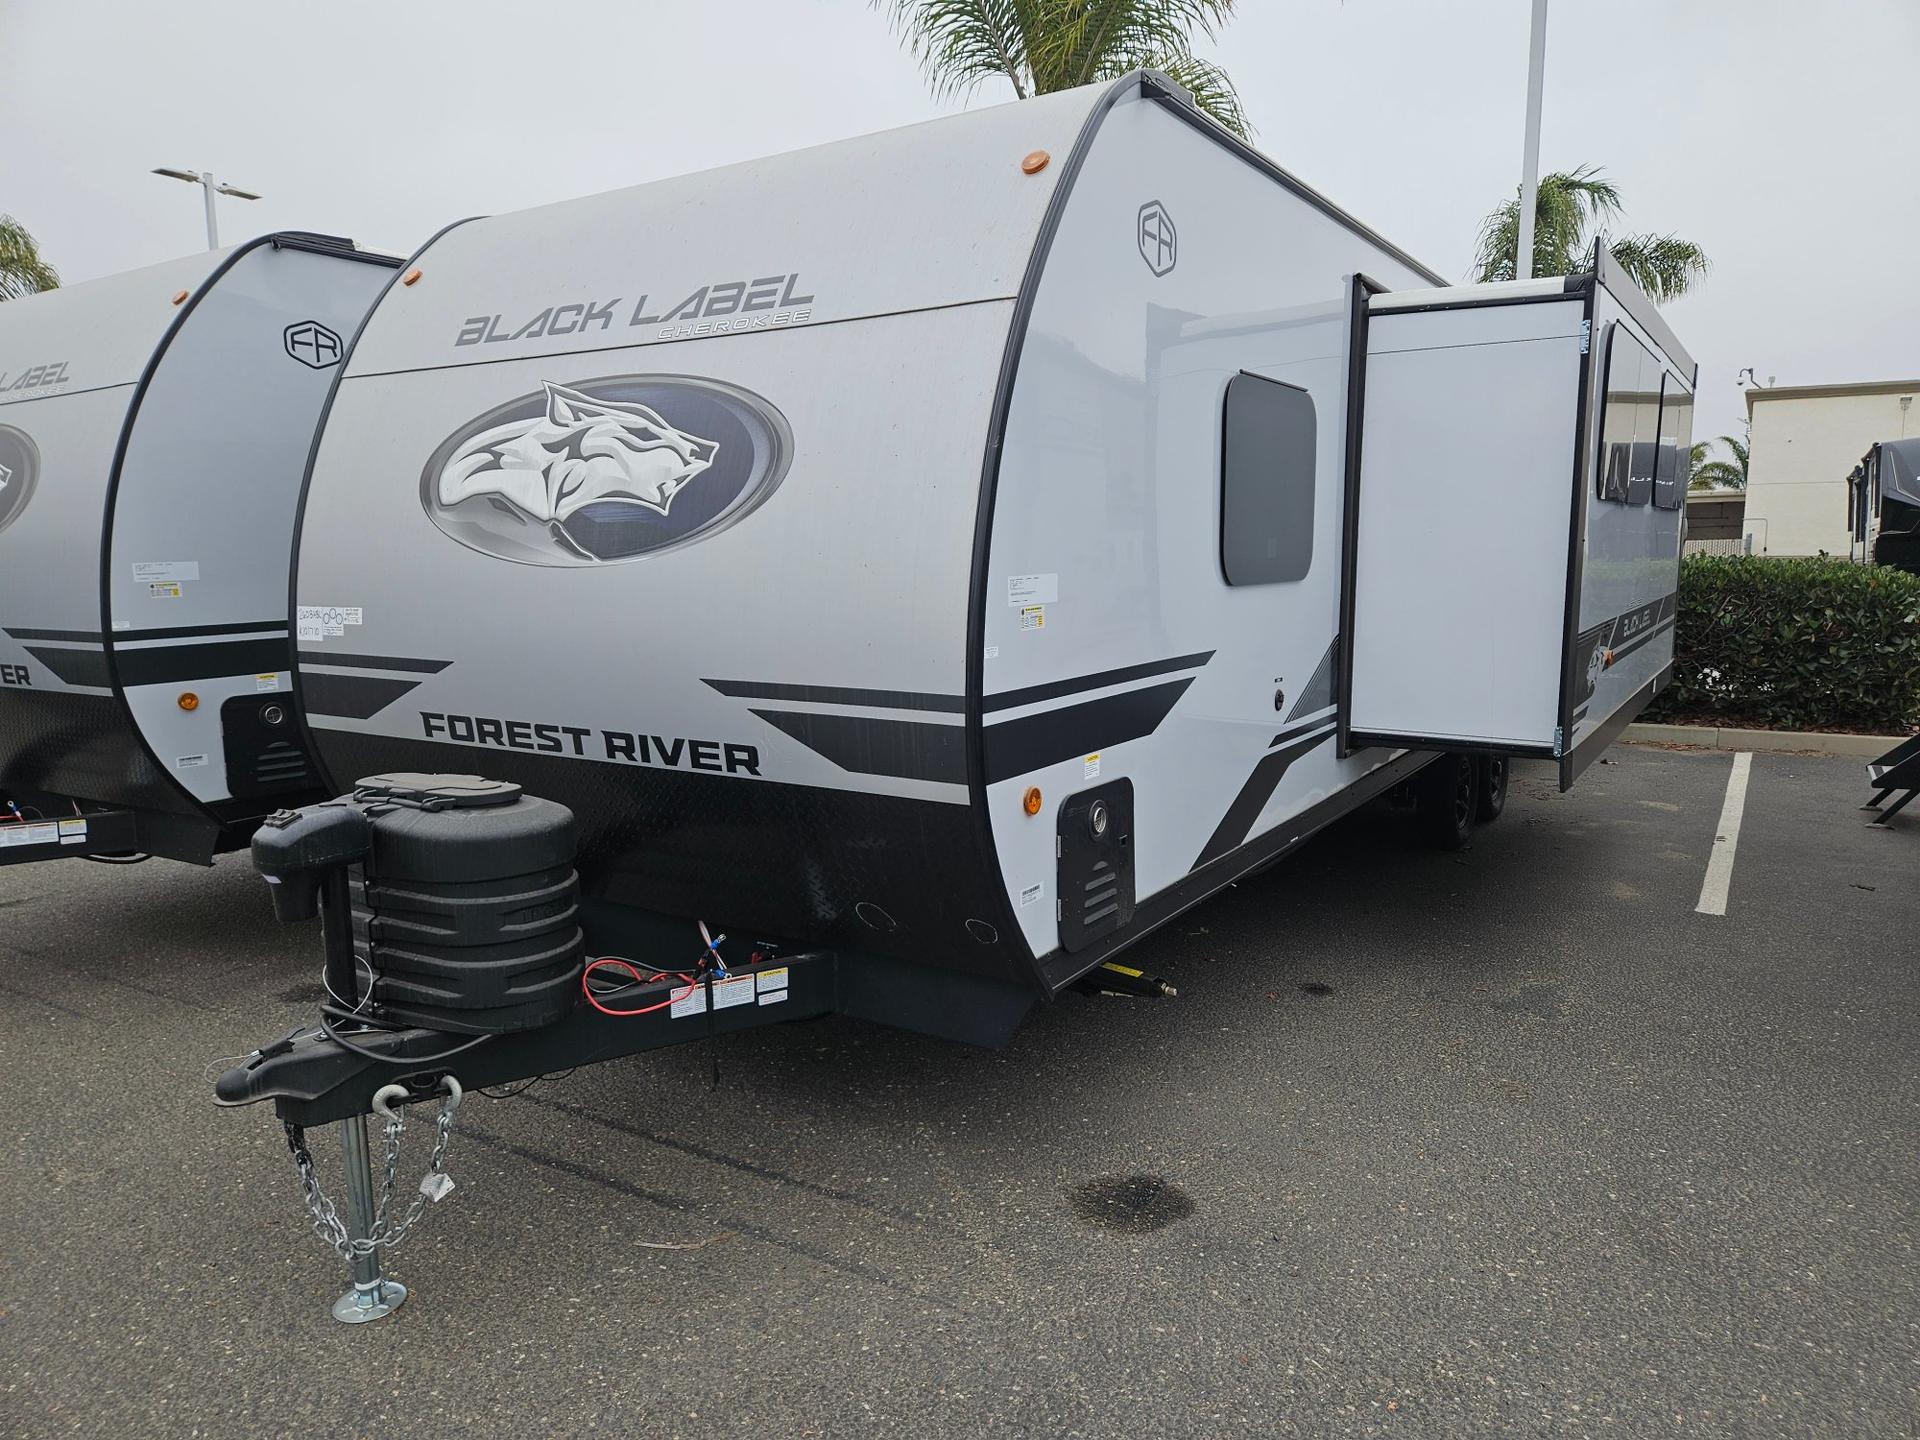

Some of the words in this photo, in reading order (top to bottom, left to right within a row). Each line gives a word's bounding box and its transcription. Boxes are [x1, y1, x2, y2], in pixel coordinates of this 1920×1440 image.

[455, 297, 622, 347] BLACK
[629, 273, 815, 326] LABEL
[657, 308, 812, 340] CHEROKEE
[419, 711, 591, 756] FOREST
[600, 730, 762, 777] RIVER
